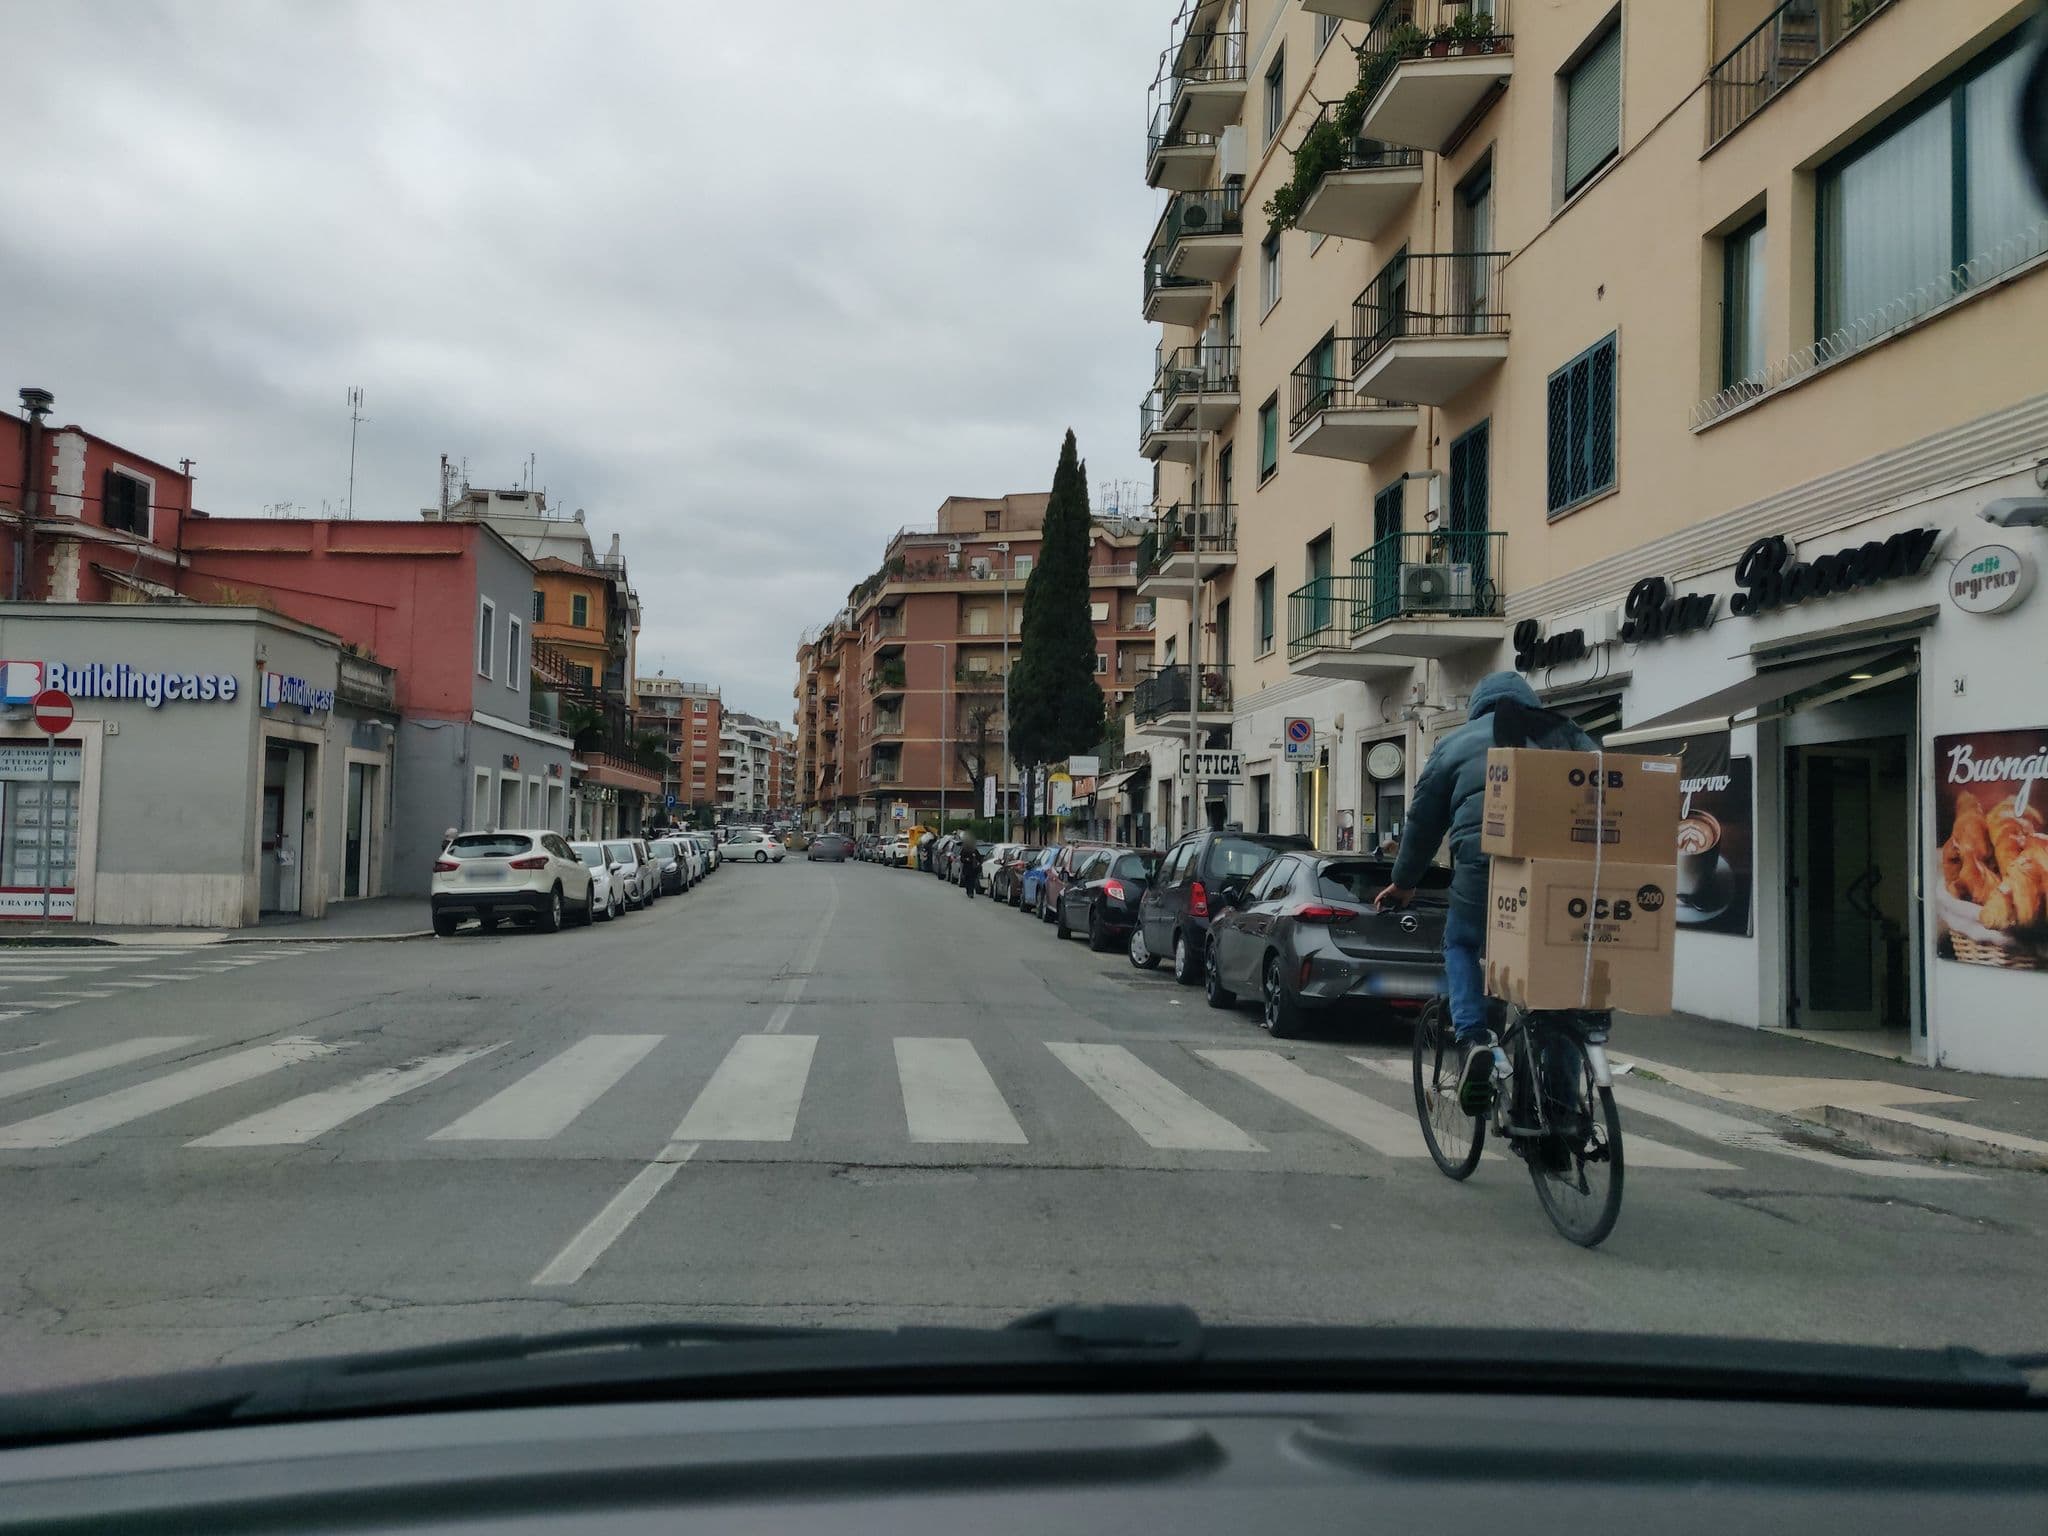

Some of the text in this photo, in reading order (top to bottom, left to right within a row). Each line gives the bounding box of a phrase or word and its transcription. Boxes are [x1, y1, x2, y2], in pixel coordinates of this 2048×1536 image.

[47, 661, 240, 709] Buildingcase
[1953, 679, 1965, 694] 34
[1183, 754, 1241, 775] OTTICA
[1488, 765, 1509, 782] OCB
[1568, 768, 1624, 789] OCB
[1497, 895, 1518, 913] OCB
[1638, 891, 1663, 904] x200
[1567, 897, 1633, 921] OCB
